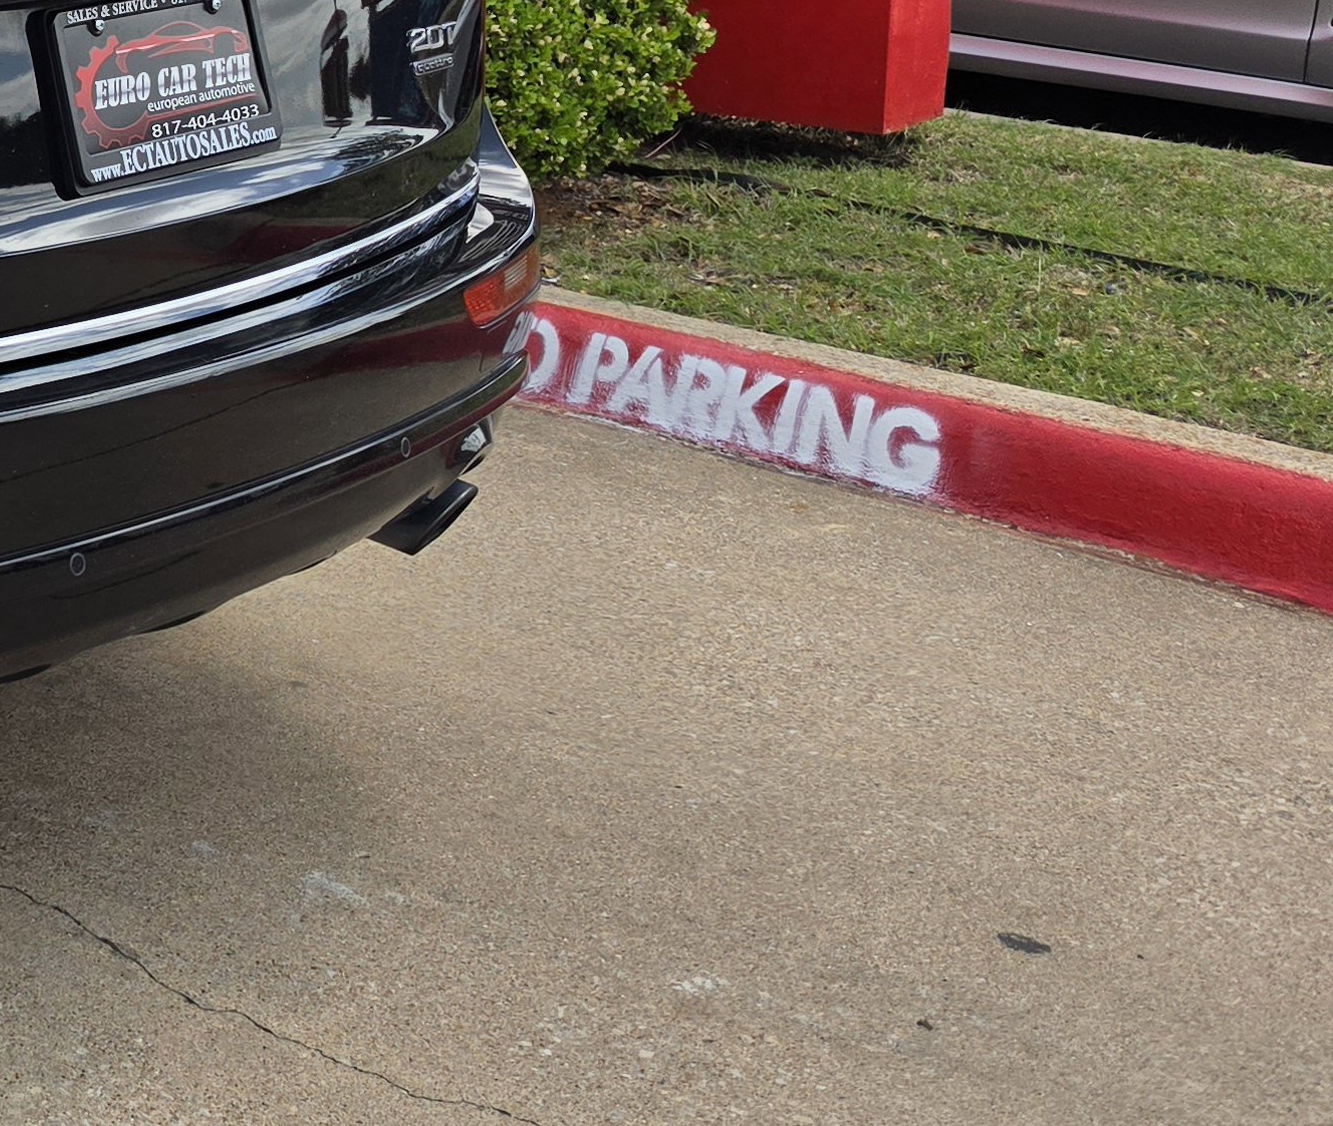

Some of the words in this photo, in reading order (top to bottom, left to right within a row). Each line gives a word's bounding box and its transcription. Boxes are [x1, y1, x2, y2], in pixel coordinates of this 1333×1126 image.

[66, 6, 98, 24] SALES
[100, 5, 110, 18] &
[95, 72, 150, 110] EURO
[157, 62, 197, 97] CAR
[202, 53, 252, 88] TECH
[147, 93, 197, 112] european
[199, 81, 255, 103] automotive
[151, 104, 259, 138] 817-404-4033
[91, 122, 277, 183] www.ECTAUTOSALES.com
[567, 331, 942, 497] PARKING
